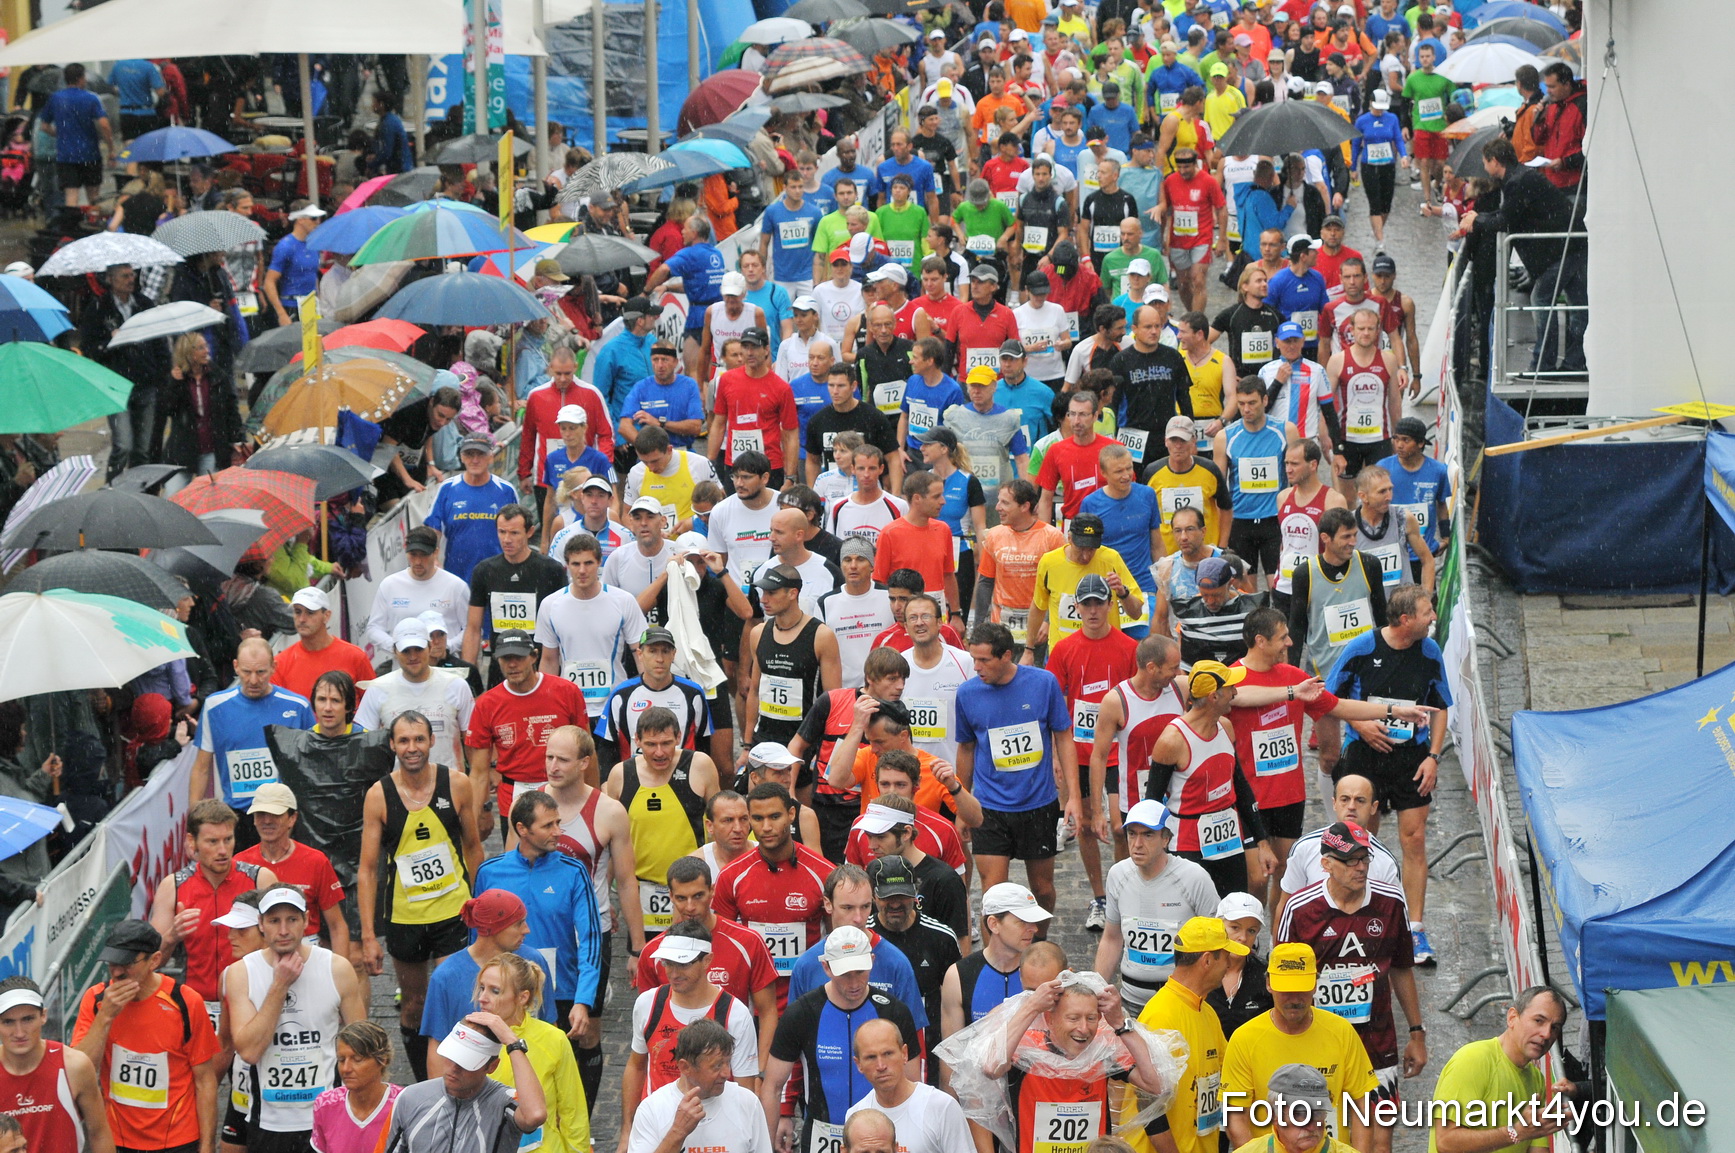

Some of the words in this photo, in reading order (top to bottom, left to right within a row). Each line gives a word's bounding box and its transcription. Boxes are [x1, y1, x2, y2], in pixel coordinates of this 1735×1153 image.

[782, 228, 806, 239] 2107
[1096, 233, 1118, 243] 2315
[969, 240, 992, 250] 2055
[890, 247, 912, 258] 2056
[1248, 340, 1268, 352] 585
[970, 356, 996, 367] 2120
[884, 390, 899, 402] 72
[910, 413, 934, 428] 2045
[1358, 415, 1371, 426] 46
[733, 438, 758, 451] 2351
[1119, 434, 1142, 449] 2068
[1251, 467, 1267, 480] 94
[1175, 497, 1191, 510] 62
[1287, 526, 1308, 535] LAC
[1000, 552, 1038, 560] Fischer
[1380, 554, 1397, 571] 77
[500, 604, 527, 619] 103
[499, 620, 527, 629] Christoph
[1340, 612, 1358, 629] 75
[1340, 629, 1363, 640] Gerhard
[569, 670, 606, 687] 2110
[770, 689, 787, 704] 15
[768, 706, 788, 715] Martin
[1268, 712, 1280, 720] DEHN
[1078, 712, 1099, 728] 26
[913, 729, 931, 738] Georg
[1002, 735, 1033, 756] 312
[1259, 738, 1295, 760] 2035
[1008, 755, 1031, 766] Fabian
[1268, 759, 1290, 769] Manfred
[233, 760, 273, 780] 3085
[1204, 820, 1236, 844] 2032
[412, 859, 444, 884] 583
[422, 882, 443, 892] Dieter
[650, 895, 671, 913] 62
[1128, 930, 1172, 952] 2212
[774, 960, 789, 968] niel
[1141, 955, 1156, 964] Uwe
[1319, 984, 1368, 1005] 3023
[1332, 1008, 1356, 1017] Ewald
[120, 1064, 156, 1088] 810
[268, 1065, 318, 1088] 3247
[275, 1091, 312, 1101] Christian
[1201, 1091, 1220, 1114] 20
[0, 1104, 54, 1116] CHWANDORF
[1049, 1119, 1089, 1141] 202
[818, 1137, 842, 1153] 20
[1052, 1144, 1083, 1153] Herbert
